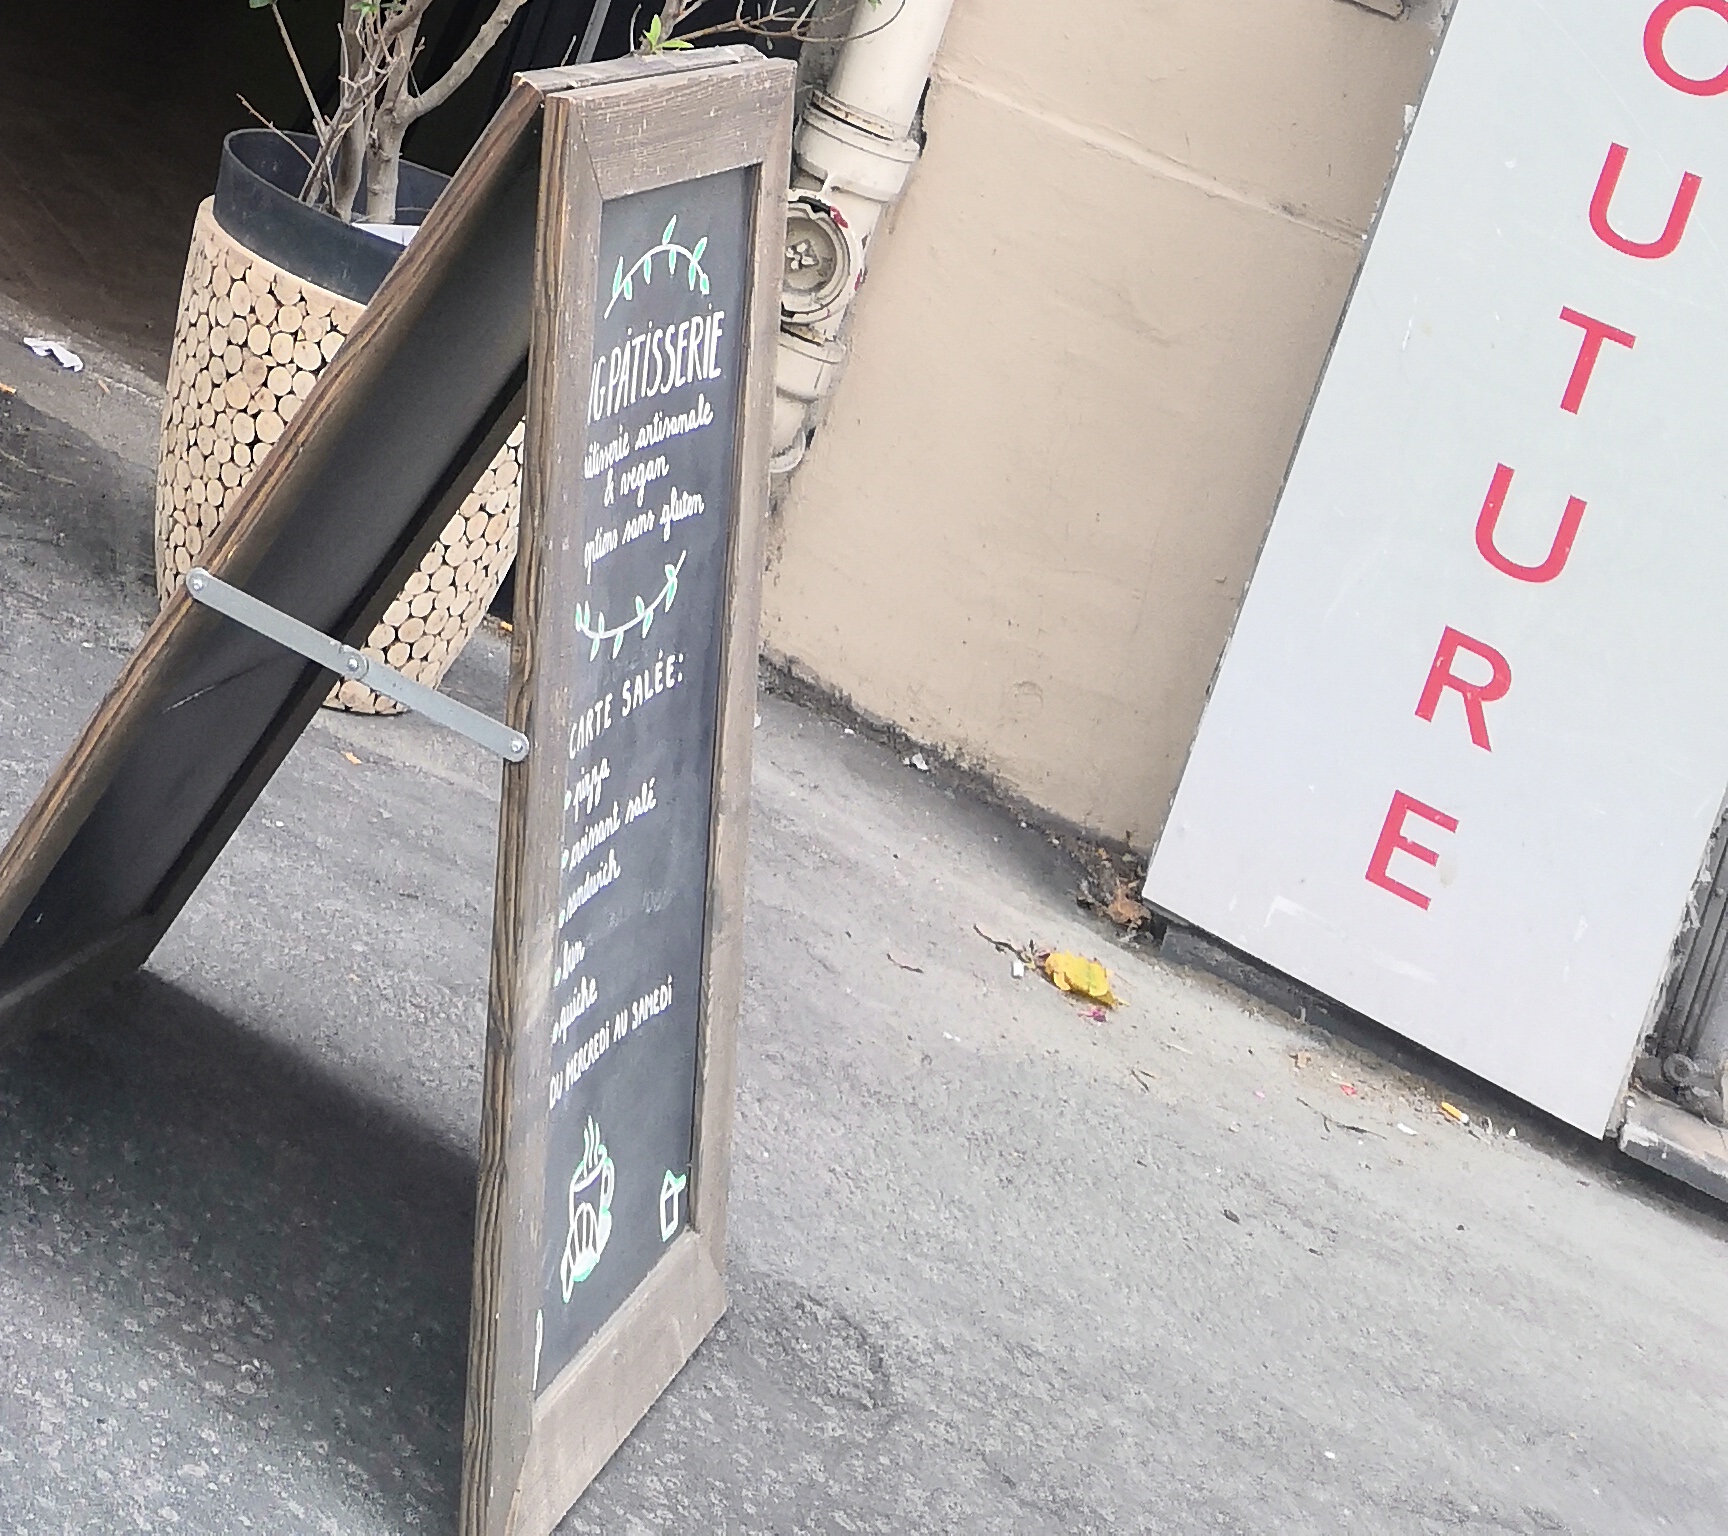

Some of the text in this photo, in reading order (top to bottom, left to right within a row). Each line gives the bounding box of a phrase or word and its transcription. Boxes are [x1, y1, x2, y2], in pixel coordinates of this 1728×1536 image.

[634, 392, 714, 451] artisanale
[620, 452, 670, 510] vegan
[622, 506, 656, 545] sans
[658, 486, 705, 542] gluten
[568, 692, 613, 760] CARTE
[573, 757, 611, 824] pizza
[624, 776, 657, 825] salé
[549, 973, 674, 1110] DU MERCREDI AU SAMEDI
[557, 975, 598, 1045] quiche
